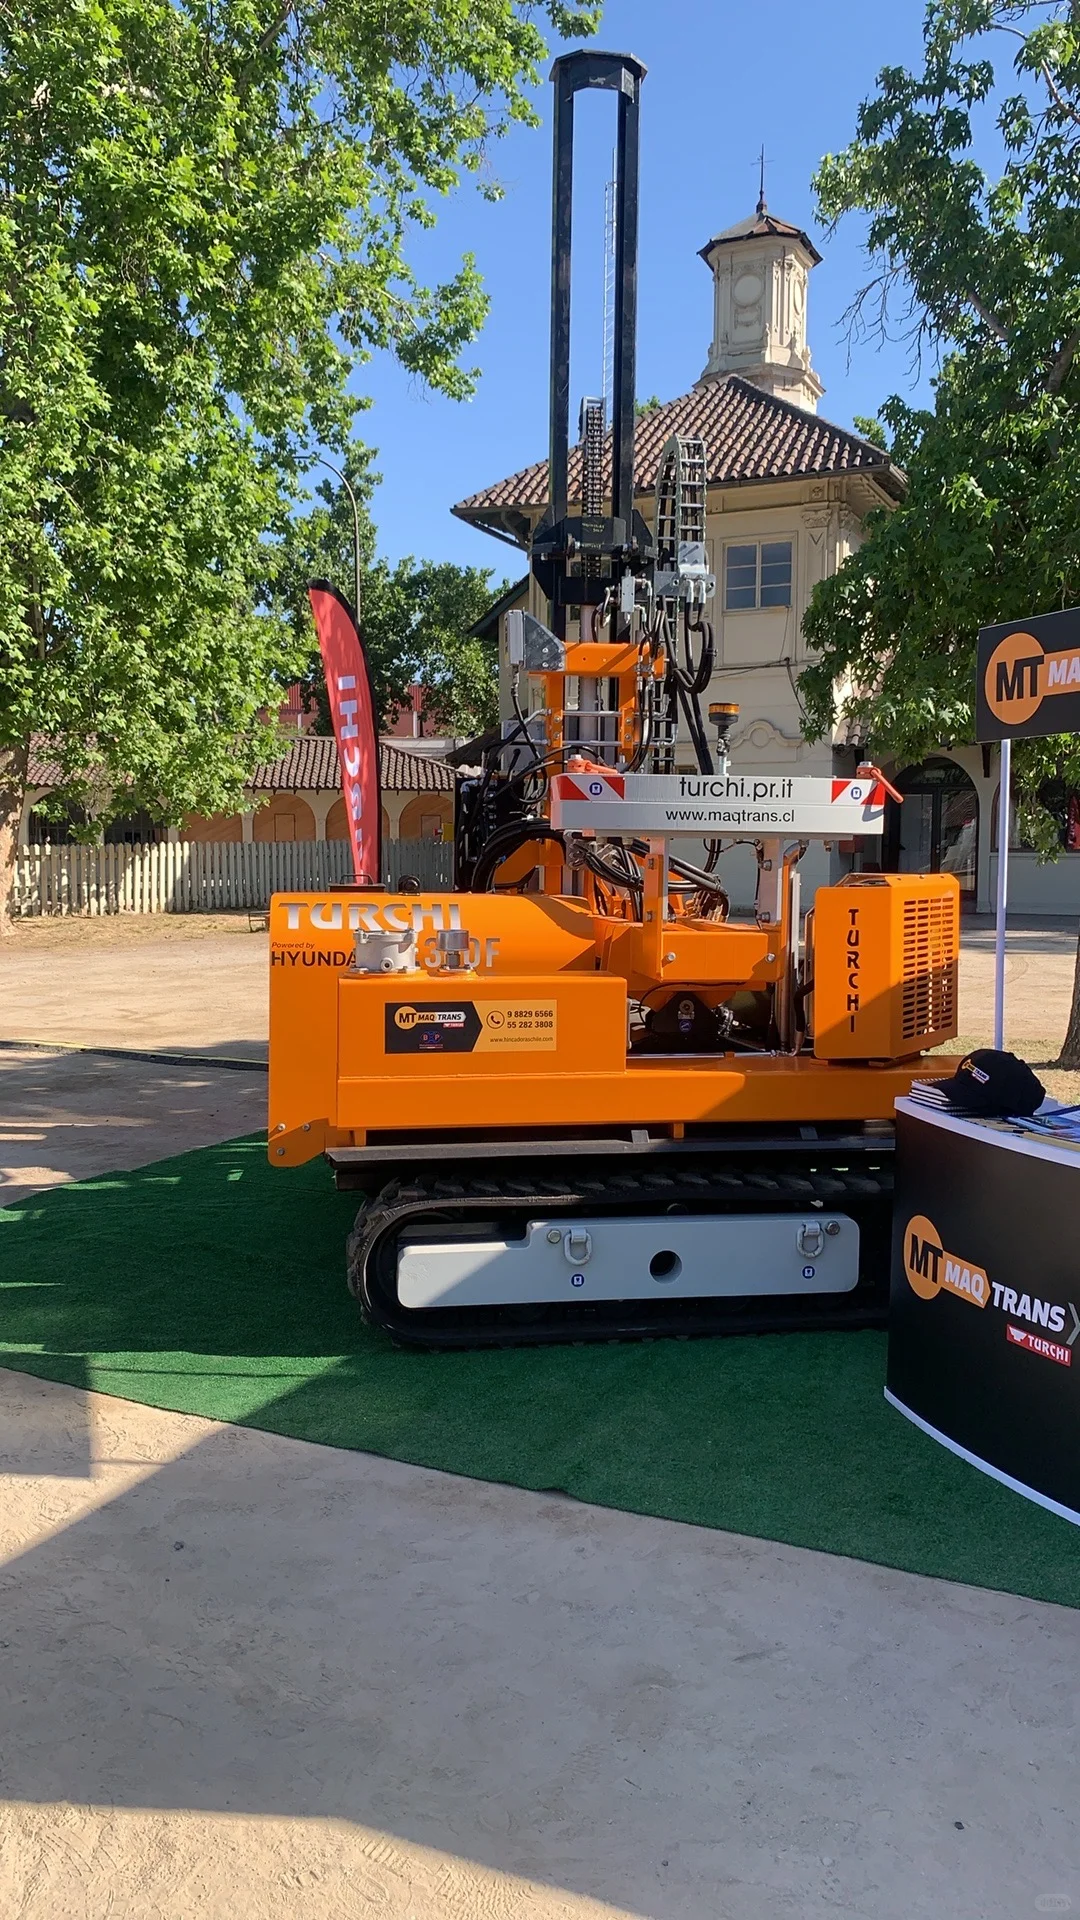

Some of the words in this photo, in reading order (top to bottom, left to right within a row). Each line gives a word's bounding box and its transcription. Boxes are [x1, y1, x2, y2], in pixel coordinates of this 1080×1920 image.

[996, 655, 1045, 703] MT
[1048, 656, 1080, 687] MA
[680, 777, 793, 802] turchi.pr.it
[665, 809, 794, 825] www.maqtrans.cl
[278, 903, 462, 931] TURCHI
[306, 942, 315, 950] by
[424, 937, 501, 968] 30F
[271, 951, 356, 967] HYUNDA
[846, 908, 860, 1033] TURCHI
[399, 1013, 417, 1024] MT
[507, 1010, 513, 1018] 9
[514, 1010, 533, 1018] 8829
[534, 1010, 553, 1018] 6566
[507, 1021, 517, 1029] 55
[518, 1021, 533, 1029] 282
[909, 1233, 944, 1285] MT
[945, 1260, 985, 1305] MAQ
[991, 1281, 1066, 1333] TRANS
[1027, 1334, 1070, 1362] TURCHI
